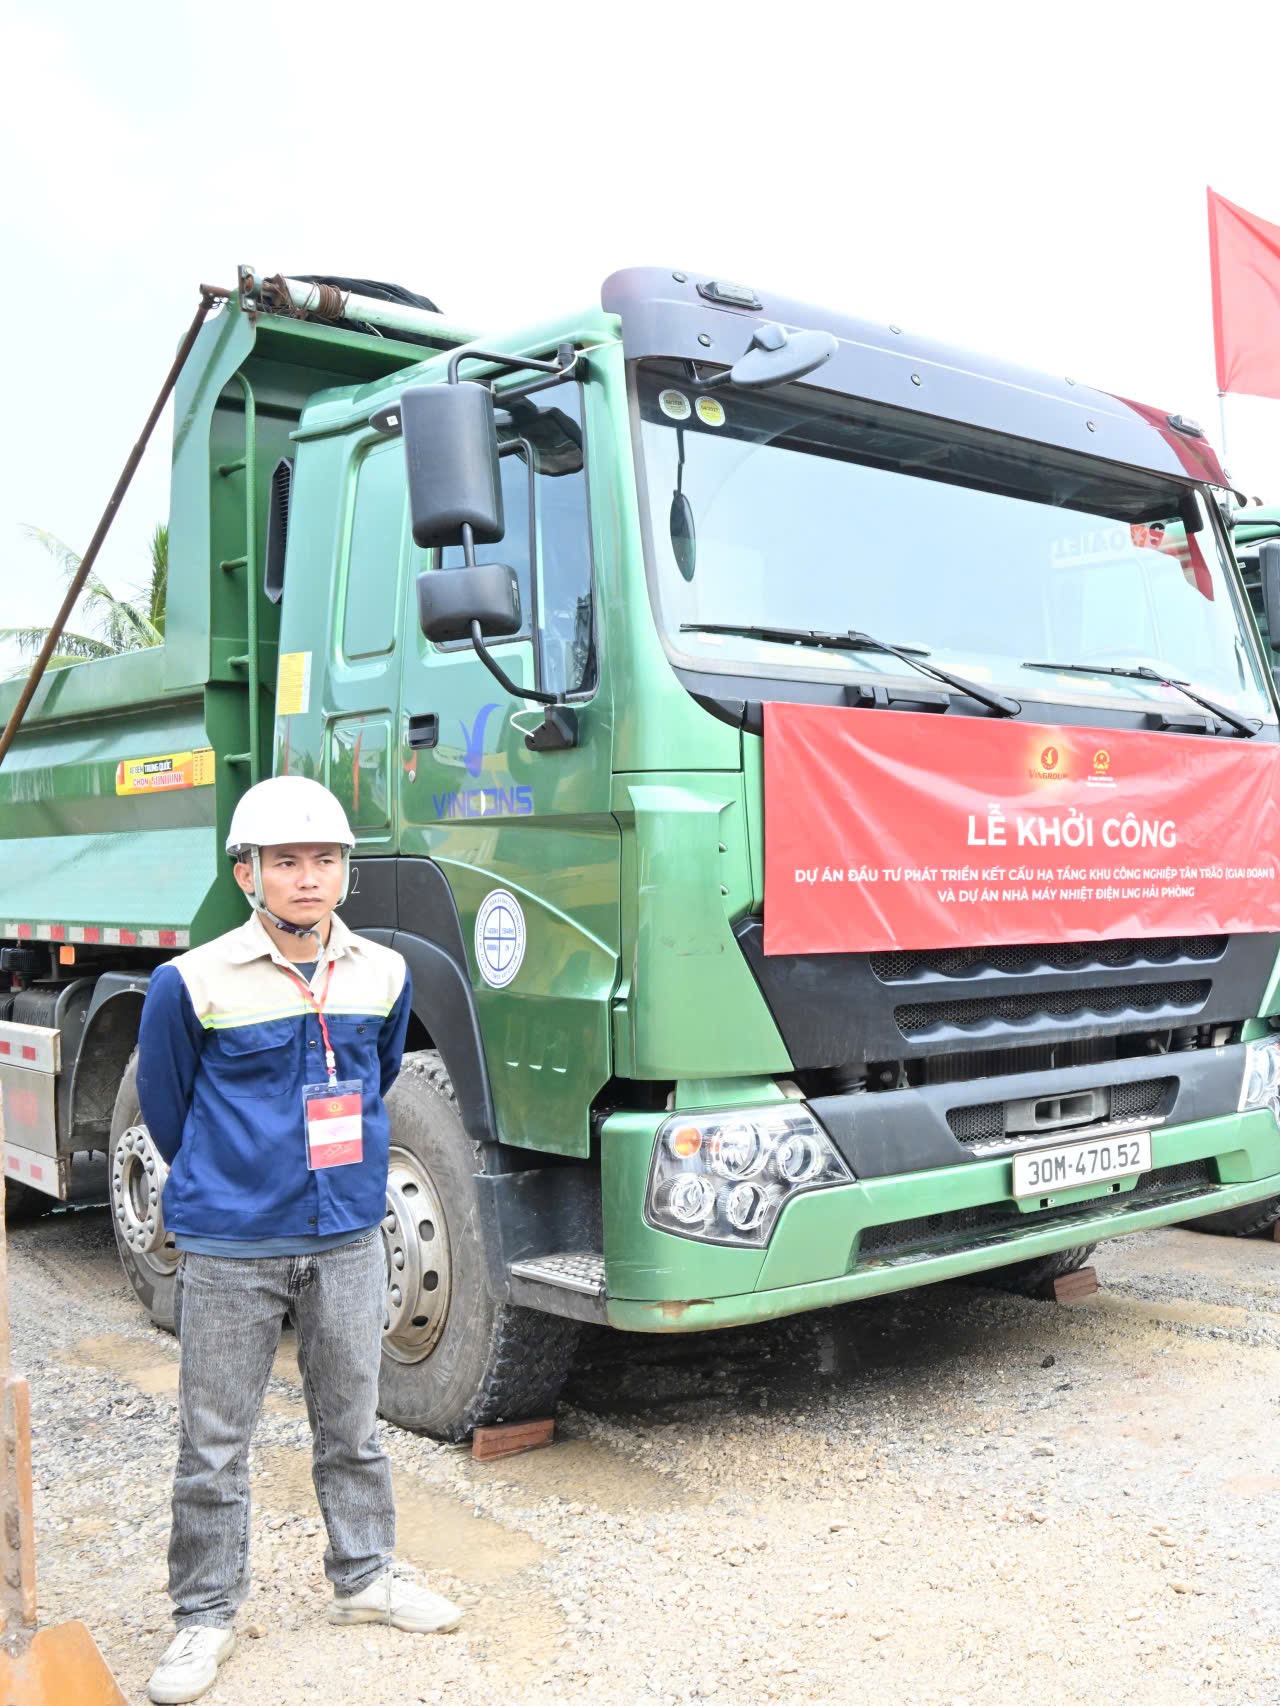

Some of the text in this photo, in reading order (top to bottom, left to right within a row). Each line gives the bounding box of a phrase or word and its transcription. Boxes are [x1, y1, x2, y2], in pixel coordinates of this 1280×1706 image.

[432, 785, 534, 820] VINCONS
[967, 803, 1177, 848] LỄ KHỞI CÔNG
[795, 867, 818, 886] DỰ
[821, 866, 844, 882] ÁN
[882, 867, 902, 881] TƯ
[904, 866, 938, 881] PHÁT
[982, 865, 1006, 880] KẾT
[1008, 865, 1034, 880] CẤU
[1037, 869, 1054, 884] HẠ
[1089, 868, 1111, 880] KHU
[1113, 866, 1141, 880] CÔNG
[1143, 866, 1178, 882] NGHIỆP
[1179, 866, 1198, 879] TÂN
[1225, 867, 1245, 880] (GIAI
[937, 883, 1195, 905] VÀ DỰ ÁN NHÀ MÁY NHIỆT ĐIỆN LNG HẢI PHÒNG
[1028, 1142, 1140, 1186] 30M-470.52
